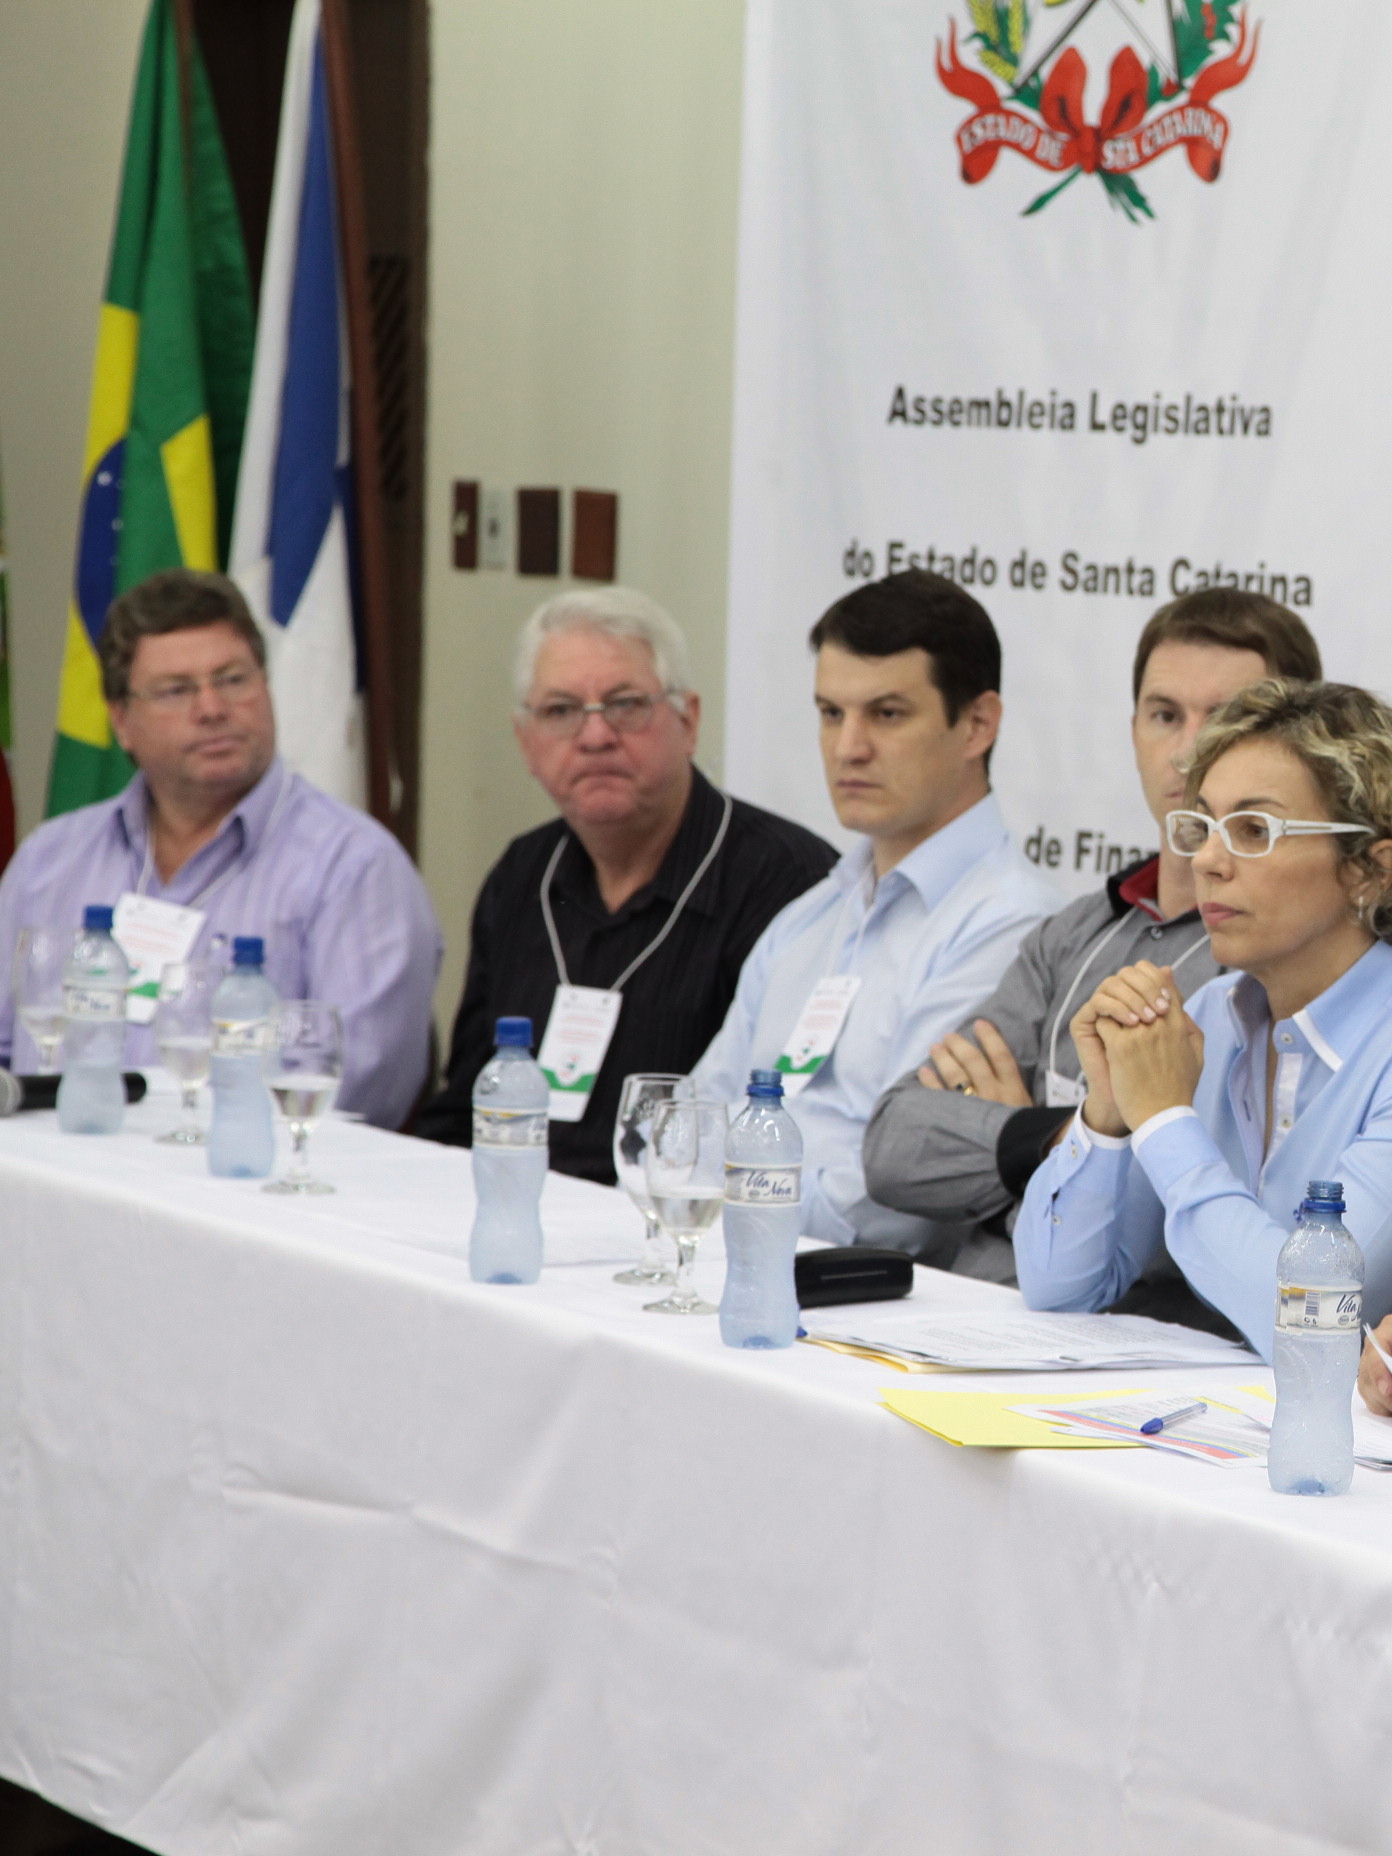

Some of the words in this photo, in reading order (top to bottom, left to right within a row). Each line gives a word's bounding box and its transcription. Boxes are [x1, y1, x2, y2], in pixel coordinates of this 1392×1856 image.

[960, 112, 1039, 155] ESTADO
[1034, 132, 1065, 169] DE
[1140, 106, 1225, 157] CATARINA
[887, 384, 1076, 432] Assembleia
[1088, 389, 1273, 445] Legislativa
[842, 538, 875, 578] do
[1009, 547, 1047, 590] de
[1059, 551, 1156, 598] Santa
[1170, 556, 1313, 607] Catarina
[1024, 824, 1062, 868] de
[1073, 829, 1146, 874] Fina
